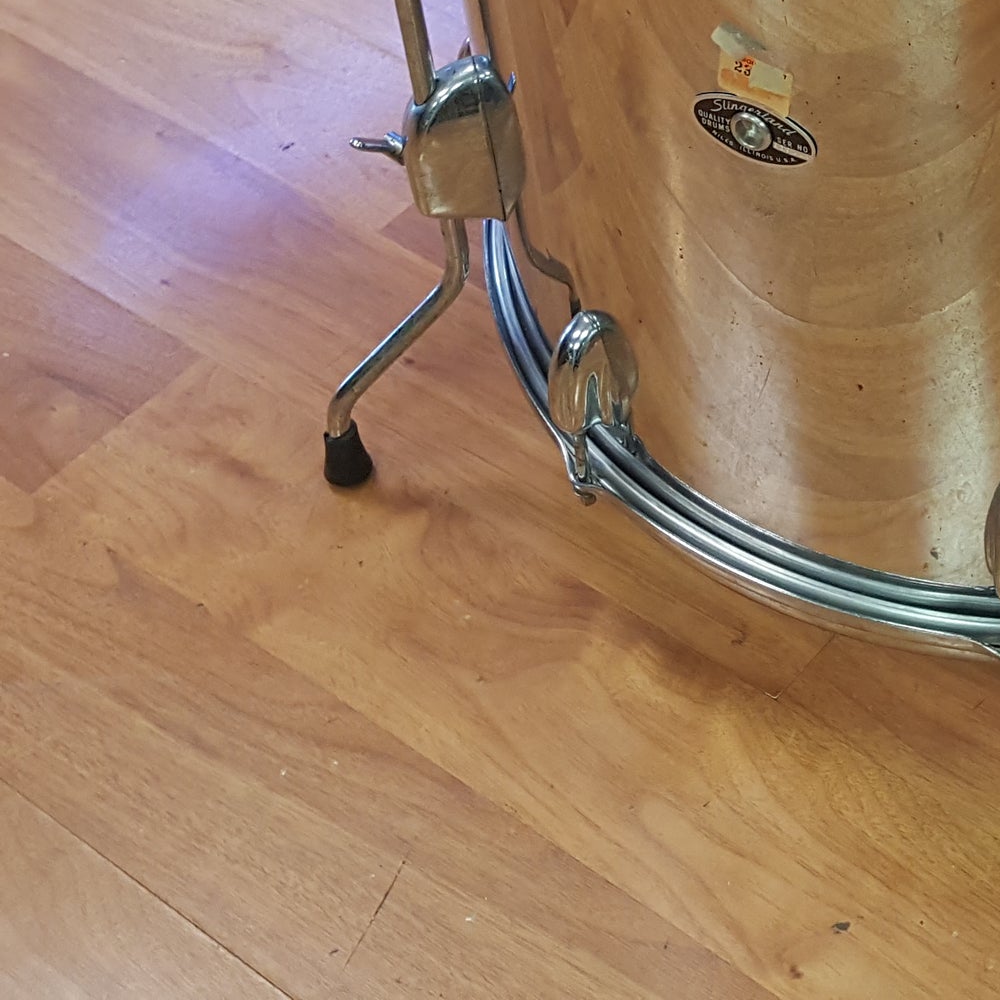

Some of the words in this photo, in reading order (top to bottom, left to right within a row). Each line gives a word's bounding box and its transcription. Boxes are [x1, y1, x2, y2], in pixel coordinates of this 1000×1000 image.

[698, 109, 731, 125] QUALITY
[701, 117, 731, 133] DRUMS
[710, 99, 797, 136] Slingerland
[739, 145, 774, 161] ILLINOIS
